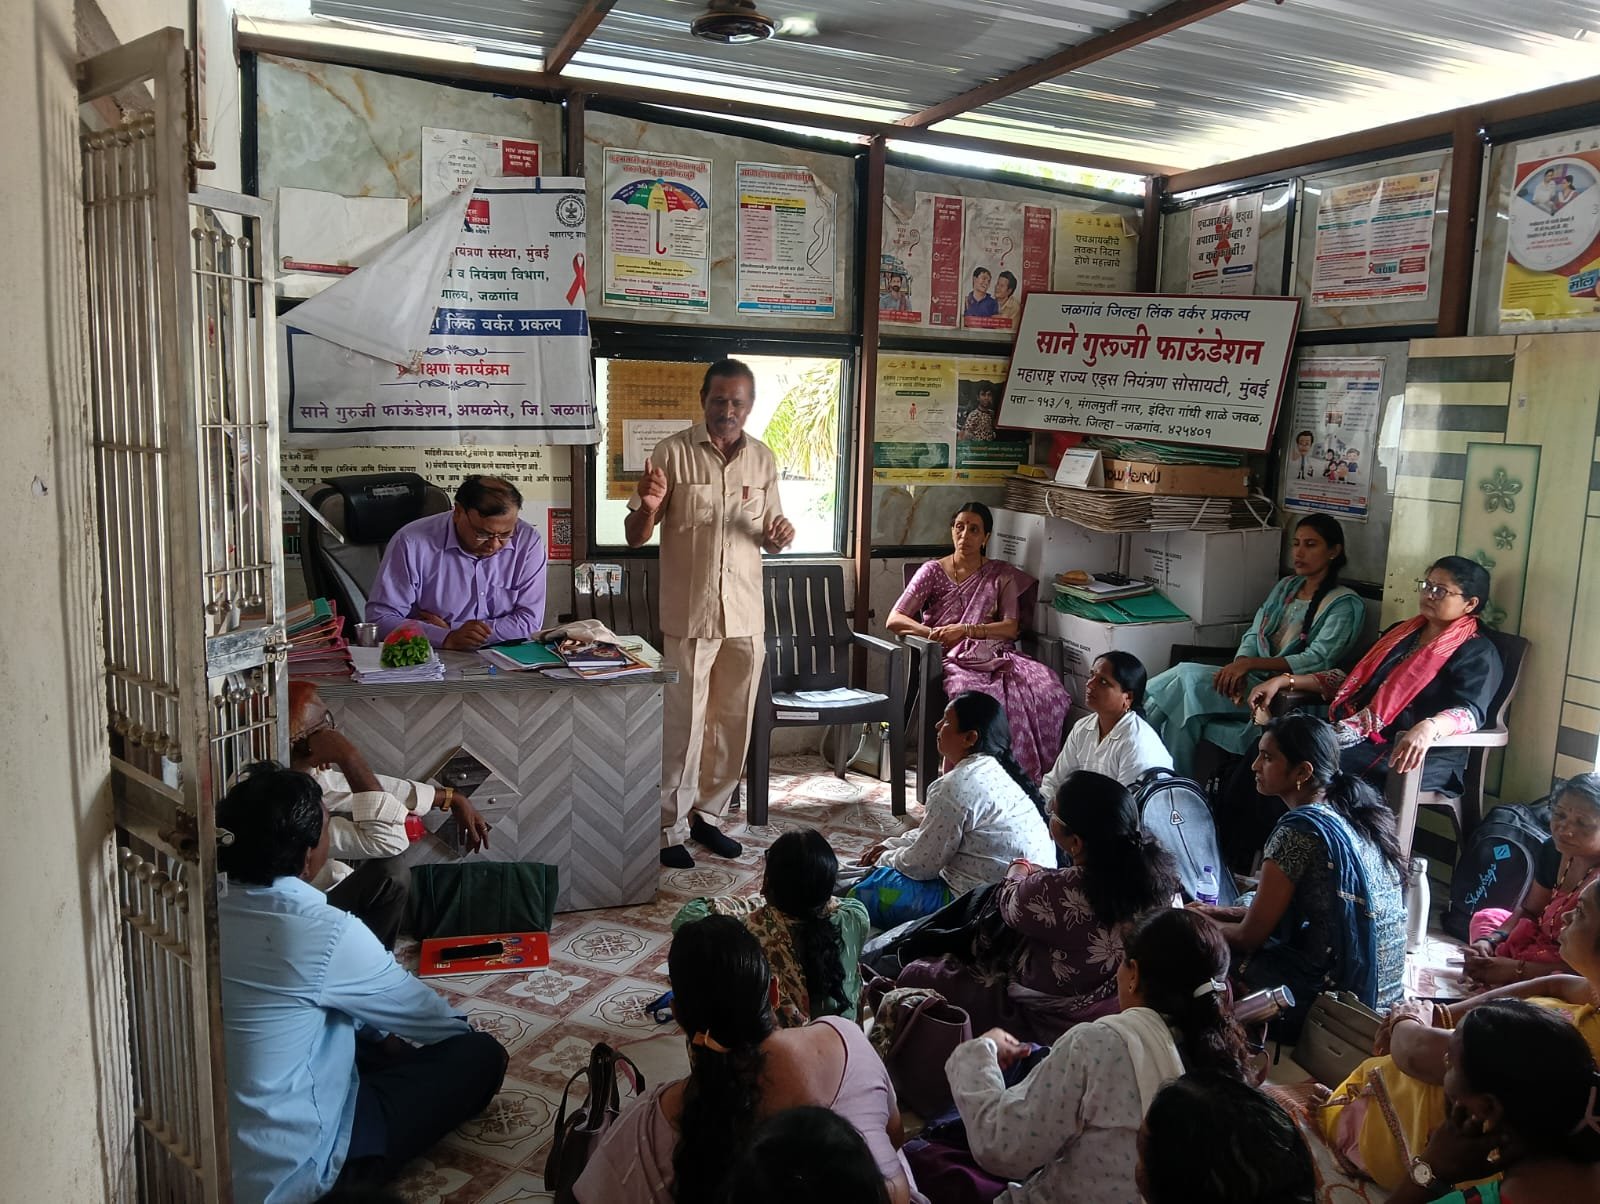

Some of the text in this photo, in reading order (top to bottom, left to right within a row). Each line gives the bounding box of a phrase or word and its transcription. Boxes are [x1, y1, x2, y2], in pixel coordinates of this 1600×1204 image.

[487, 244, 521, 260] संस्था,
[525, 244, 550, 262] मुंबई
[469, 266, 507, 281] नियंत्रण
[511, 267, 550, 282] विभाग,
[478, 287, 519, 302] जळगांव
[445, 312, 562, 332] लिंक वर्कर प्रकल्प
[1061, 301, 1252, 322] जळगांव जिल्हा लिंक वर्कर प्रकल्प
[1036, 321, 1079, 355] साने
[1156, 327, 1266, 366] फाऊंडेशन
[454, 358, 511, 377] कार्यक्रम
[1017, 367, 1271, 401] महाराष्ट्र राज्य एड्स नियंत्रण सोसायटी, मुंबई
[299, 401, 329, 419] साने
[335, 402, 377, 424] गुरुजी
[381, 400, 453, 419] फाऊंडेशन,
[456, 399, 515, 419] अमळनेर,
[520, 400, 545, 417] जि.
[1010, 394, 1027, 405] पत्ता
[1120, 403, 1144, 416] नगर,
[1148, 402, 1175, 417] इंदिरा
[1178, 404, 1202, 419] गांधी
[1205, 407, 1229, 421] शाळे
[1231, 411, 1263, 427] जवळ,
[1043, 413, 1082, 427] अमळनेर.
[1085, 415, 1115, 431] जिल्हा
[1124, 420, 1163, 434] जळगांव.
[1168, 424, 1212, 439] ४२५४०१
